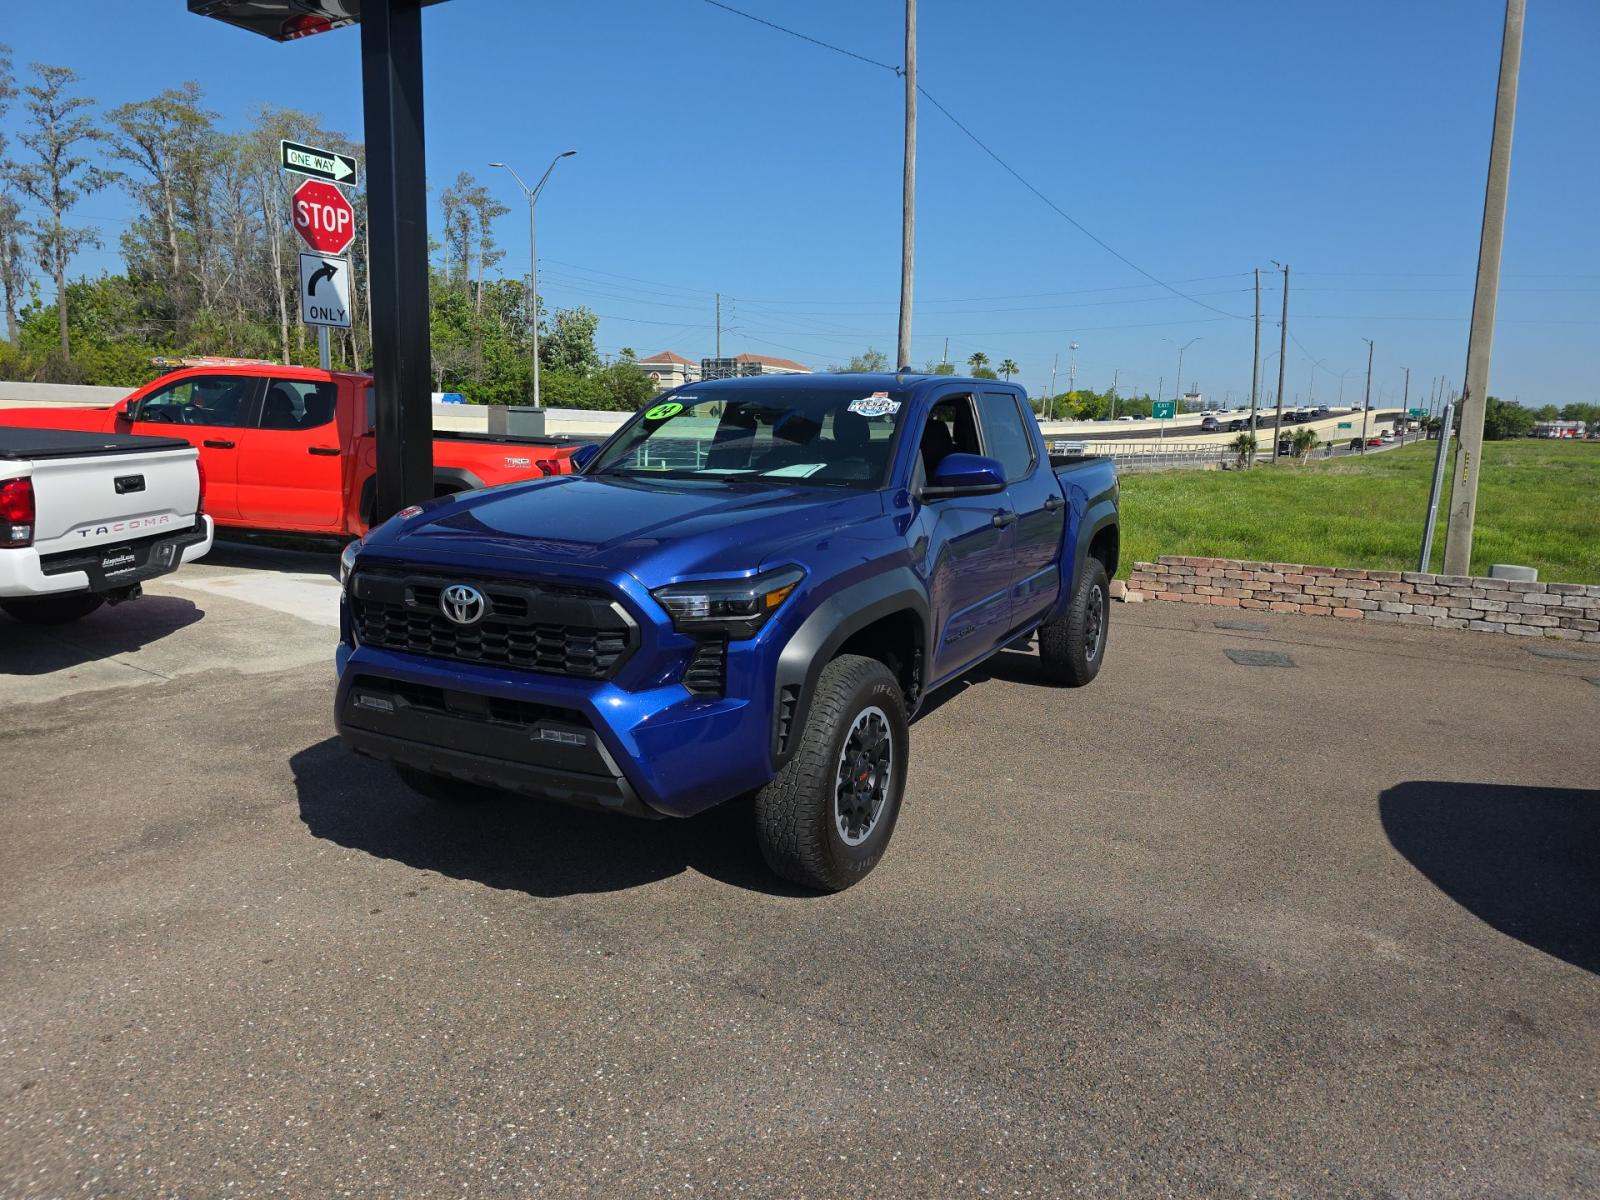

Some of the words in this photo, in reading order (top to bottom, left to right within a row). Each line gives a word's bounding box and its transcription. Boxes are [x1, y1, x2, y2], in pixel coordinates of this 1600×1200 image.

[290, 151, 311, 167] ONE
[313, 157, 335, 171] WAY
[297, 200, 350, 233] STOP
[309, 306, 346, 321] ONLY
[77, 515, 169, 537] TACOMA
